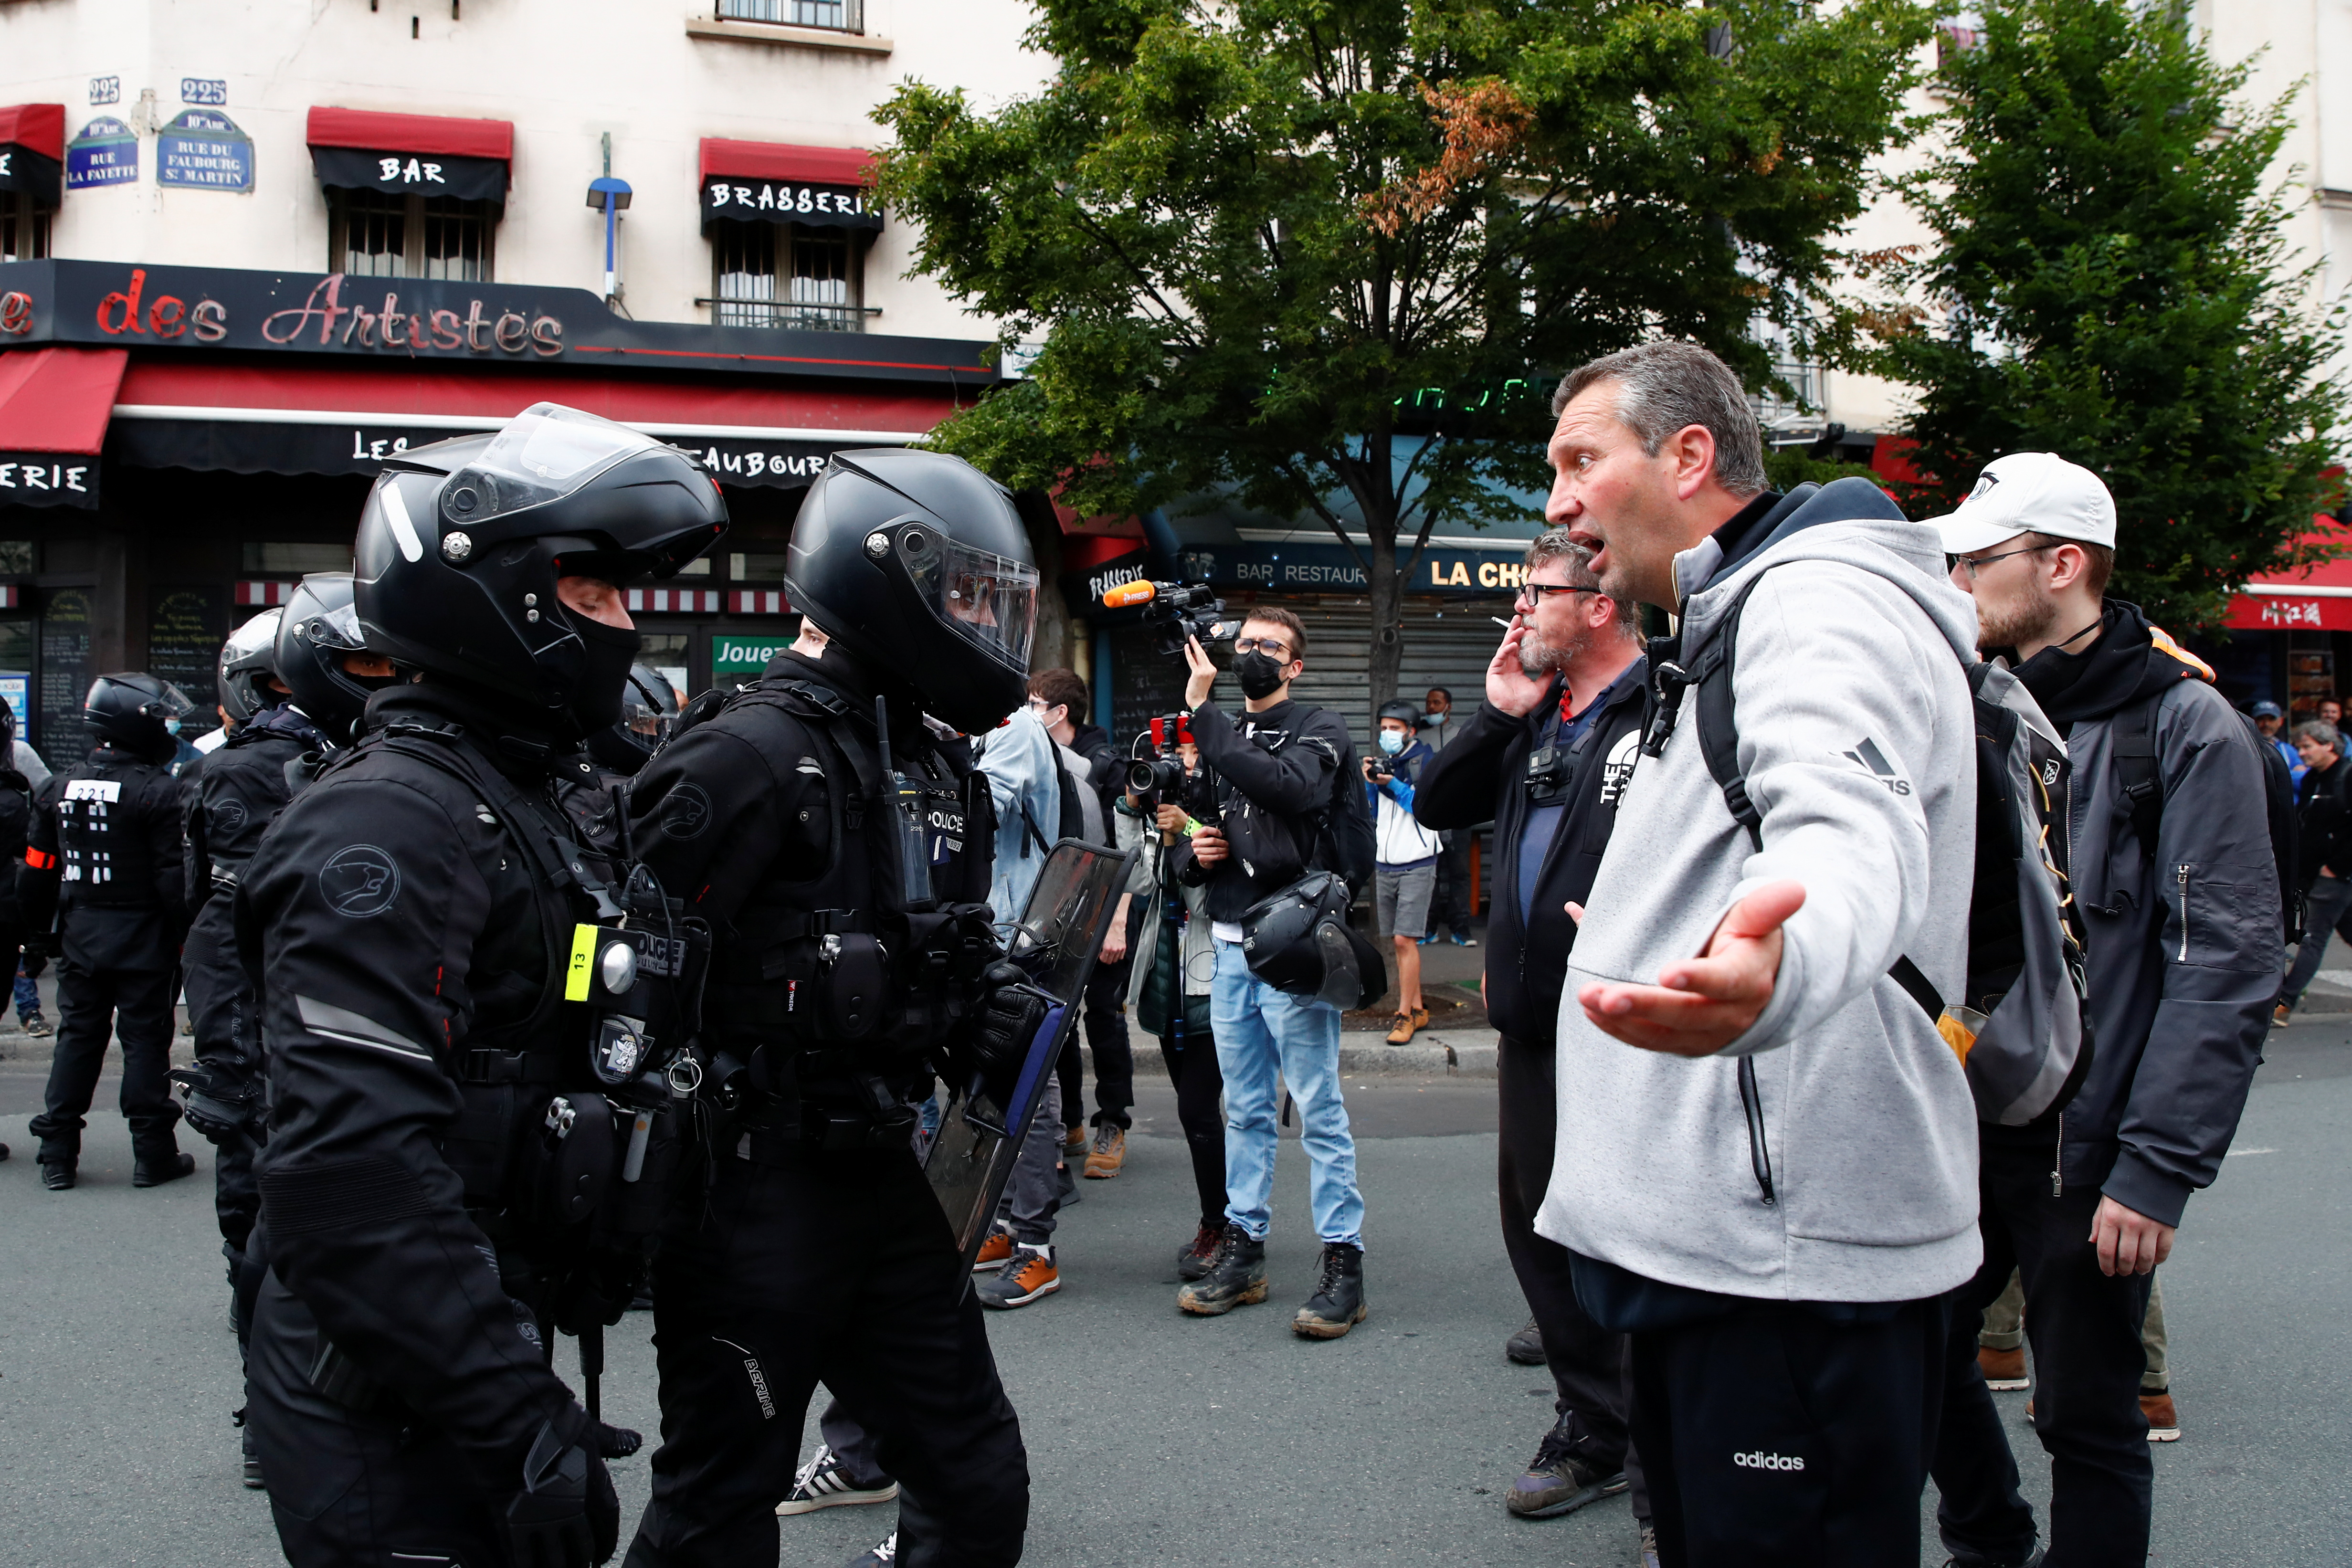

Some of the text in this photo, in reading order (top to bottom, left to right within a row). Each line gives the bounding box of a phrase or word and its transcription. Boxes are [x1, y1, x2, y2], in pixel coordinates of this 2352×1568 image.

[182, 80, 226, 104] 225
[178, 141, 232, 156] RUE DU
[90, 151, 116, 166] RUE
[168, 155, 240, 170] FAUBOURG
[68, 165, 137, 183] LA FAYETTE
[184, 169, 243, 184] MARTIN
[379, 158, 445, 184] BAR
[97, 269, 227, 341] des
[262, 273, 564, 357] Artistes
[1237, 563, 1274, 580] BAR
[1432, 561, 1471, 586] LA
[1131, 590, 1150, 601] PRESS
[1600, 765, 1622, 804] THE
[574, 953, 586, 969] 13
[744, 1358, 775, 1419] BERING
[1733, 1451, 1805, 1471] adidas
